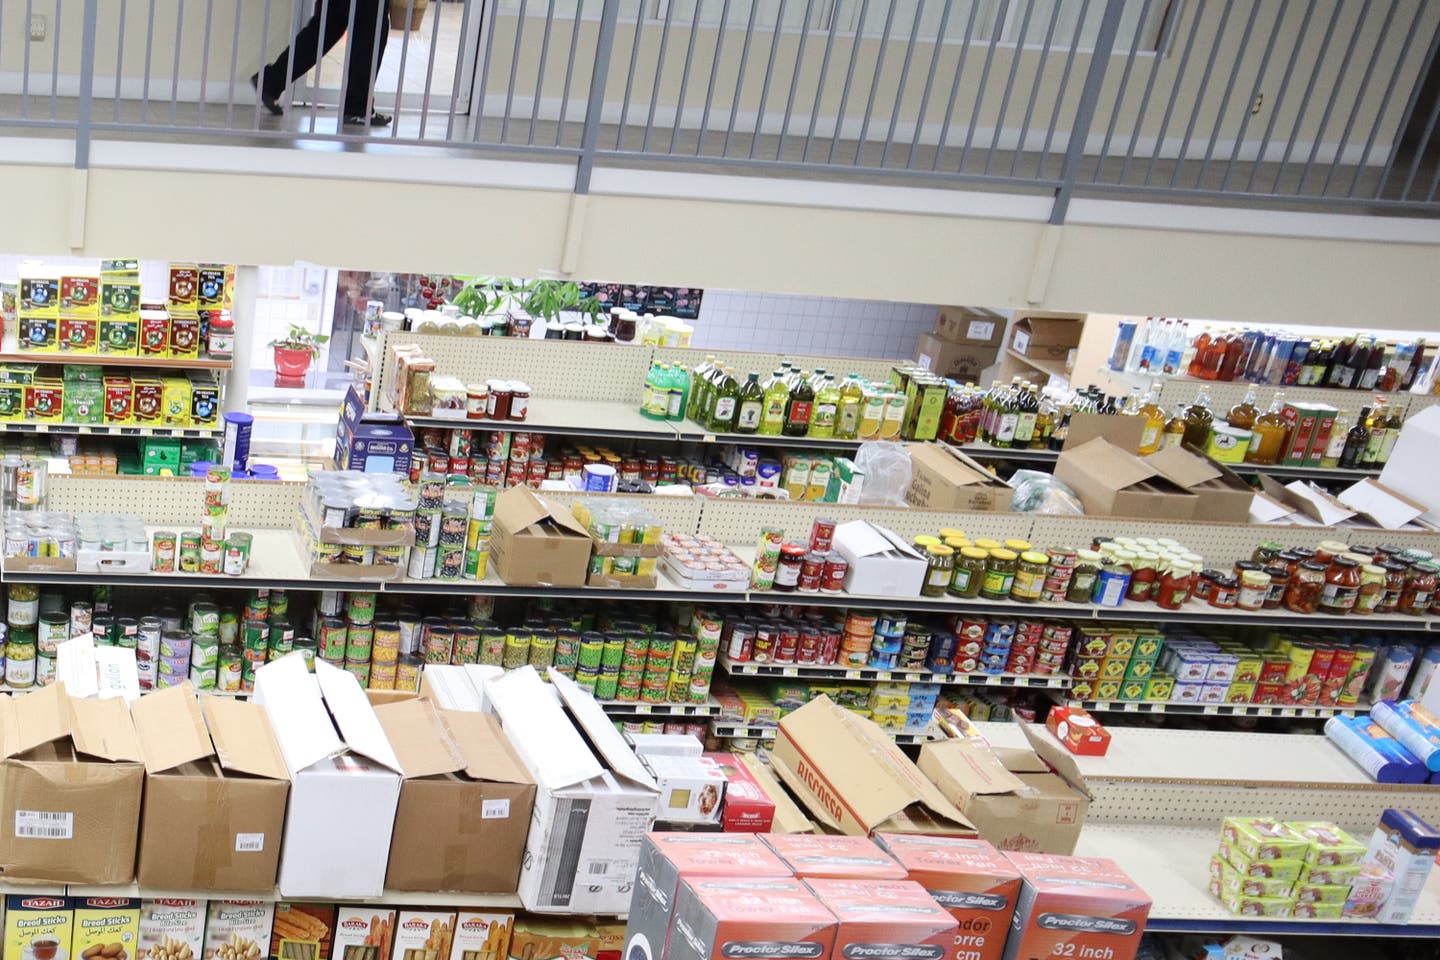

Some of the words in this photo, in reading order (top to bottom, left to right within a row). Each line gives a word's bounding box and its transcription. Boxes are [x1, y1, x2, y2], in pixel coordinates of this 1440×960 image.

[26, 900, 62, 908] TAZAH
[965, 896, 999, 907] Silex
[152, 912, 175, 920] Bread
[175, 911, 197, 919] Sticks
[221, 911, 244, 919] Bread
[244, 910, 265, 918] Sticks
[18, 919, 42, 927] Bread
[43, 916, 67, 925] Sticks
[82, 919, 106, 927] Bread
[107, 917, 131, 925] Sticks
[1044, 915, 1093, 927] Proctor
[1092, 919, 1129, 930] Silex
[954, 934, 985, 947] orre
[729, 944, 778, 955] Proctor
[779, 945, 815, 955] Silex
[850, 946, 900, 957] Proctor
[900, 948, 936, 957] Silex
[956, 950, 981, 960] cm
[1052, 943, 1076, 957] 32
[1079, 945, 1114, 960] inch
